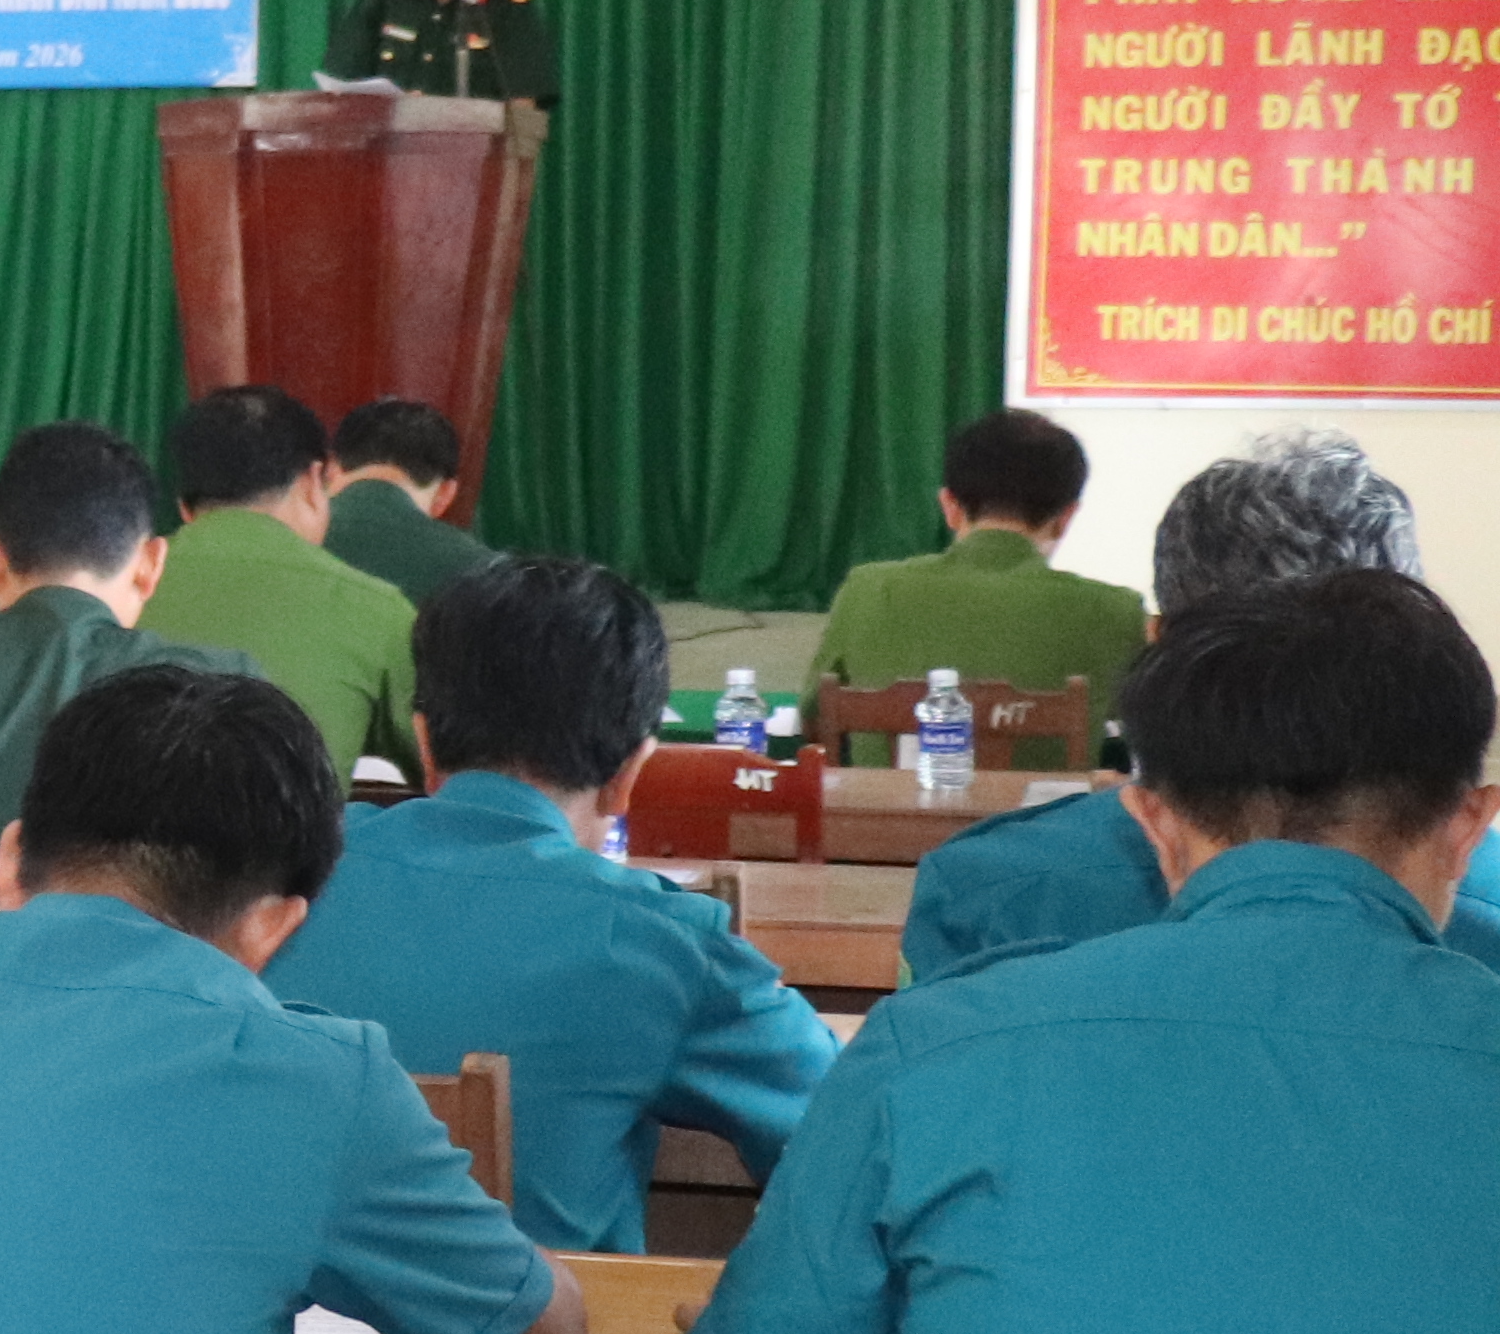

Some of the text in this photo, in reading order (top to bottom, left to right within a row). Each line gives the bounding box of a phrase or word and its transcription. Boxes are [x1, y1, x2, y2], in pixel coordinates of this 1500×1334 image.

[25, 44, 83, 69] 2026
[1084, 24, 1223, 67] NGƯỜI
[1256, 23, 1384, 66] LÃNH
[1081, 78, 1461, 130] NGƯỜI ĐẦY TỚ
[1079, 149, 1473, 194] TRUNG THÀNH
[1077, 214, 1200, 257] NHÂN
[1097, 293, 1493, 344] TRÍCH DI CHÚC HỒ CHÍ
